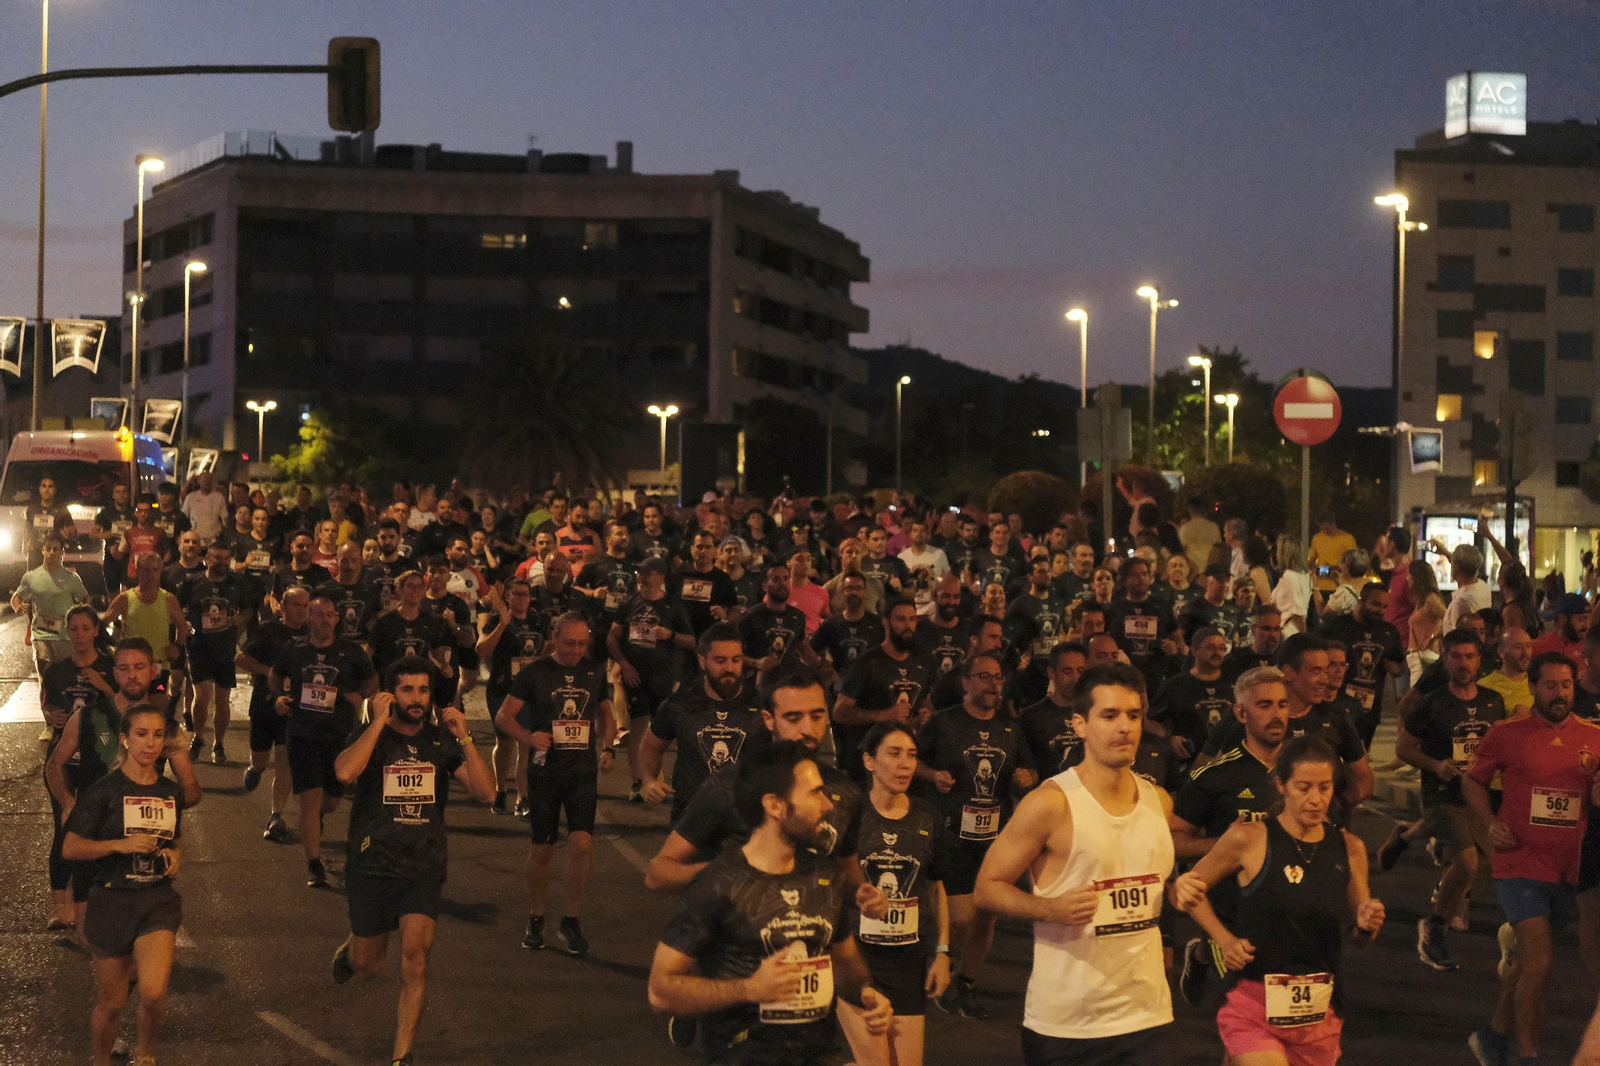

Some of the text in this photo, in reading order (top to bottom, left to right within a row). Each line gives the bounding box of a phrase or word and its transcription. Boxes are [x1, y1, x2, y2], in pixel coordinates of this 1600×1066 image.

[1476, 81, 1517, 105] AC
[1475, 104, 1518, 115] HOTELS
[311, 690, 326, 701] 579
[564, 726, 581, 737] 937
[396, 774, 423, 787] 1012
[1546, 796, 1570, 811] 562
[138, 805, 164, 820] 1011
[975, 814, 992, 827] 913
[1108, 886, 1148, 909] 1091
[1292, 985, 1311, 1003] 34
